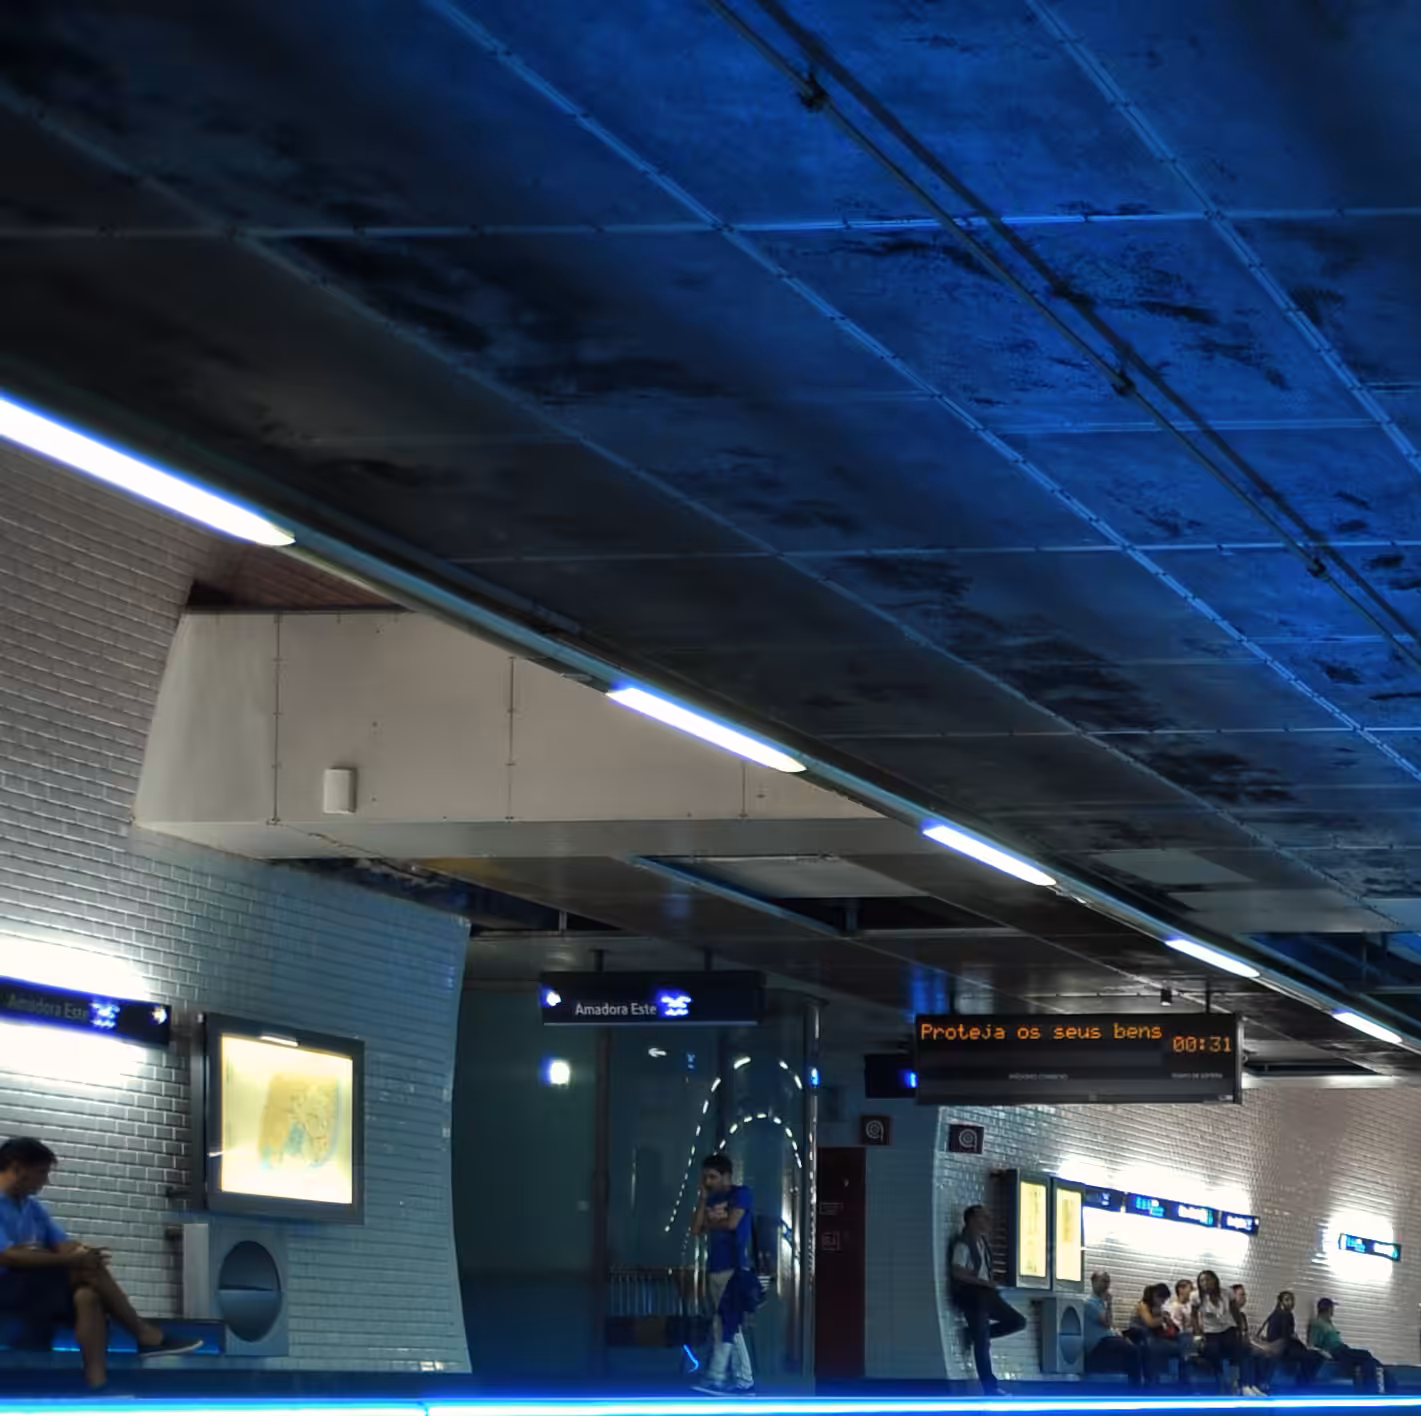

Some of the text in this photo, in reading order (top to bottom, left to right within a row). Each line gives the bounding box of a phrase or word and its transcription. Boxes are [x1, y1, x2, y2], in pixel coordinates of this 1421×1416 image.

[574, 1001, 658, 1016] Amadora Este
[920, 1022, 1164, 1041] Proteja os seus bens
[1172, 1035, 1232, 1053] 00:31
